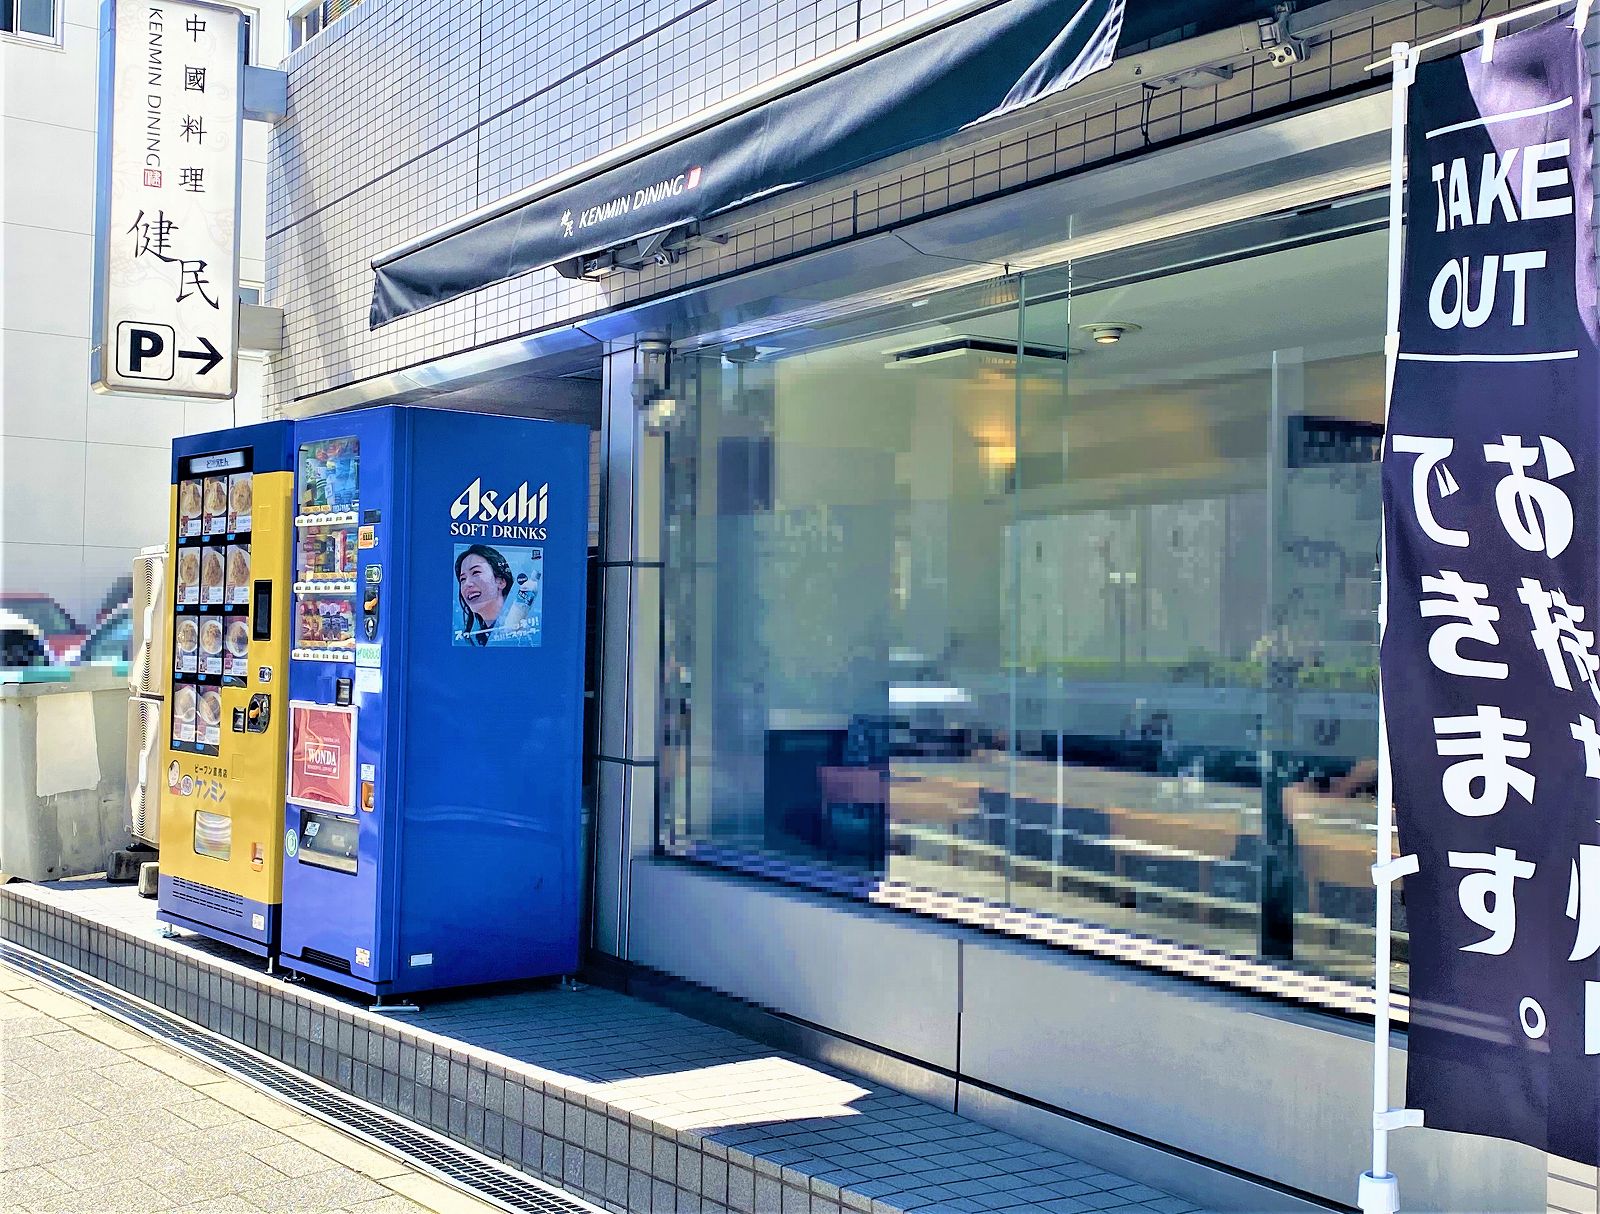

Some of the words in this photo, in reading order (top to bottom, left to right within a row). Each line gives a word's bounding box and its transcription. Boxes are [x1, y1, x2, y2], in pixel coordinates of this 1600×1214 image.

[148, 7, 164, 86] KENMIN
[145, 94, 162, 168] DINING
[178, 13, 208, 194] 中國料理
[578, 194, 631, 229] KENMIN
[632, 174, 685, 211] DINING
[1431, 138, 1573, 233] TAKE
[127, 208, 220, 310] 健民
[1428, 250, 1547, 330] OUT
[129, 328, 165, 373] P
[450, 476, 549, 525] Asahi
[450, 522, 489, 537] SOFT
[491, 524, 548, 541] DRINKS
[308, 748, 337, 766] WONDA
[1392, 433, 1548, 1040] できます。
[195, 775, 227, 803] ケンミン
